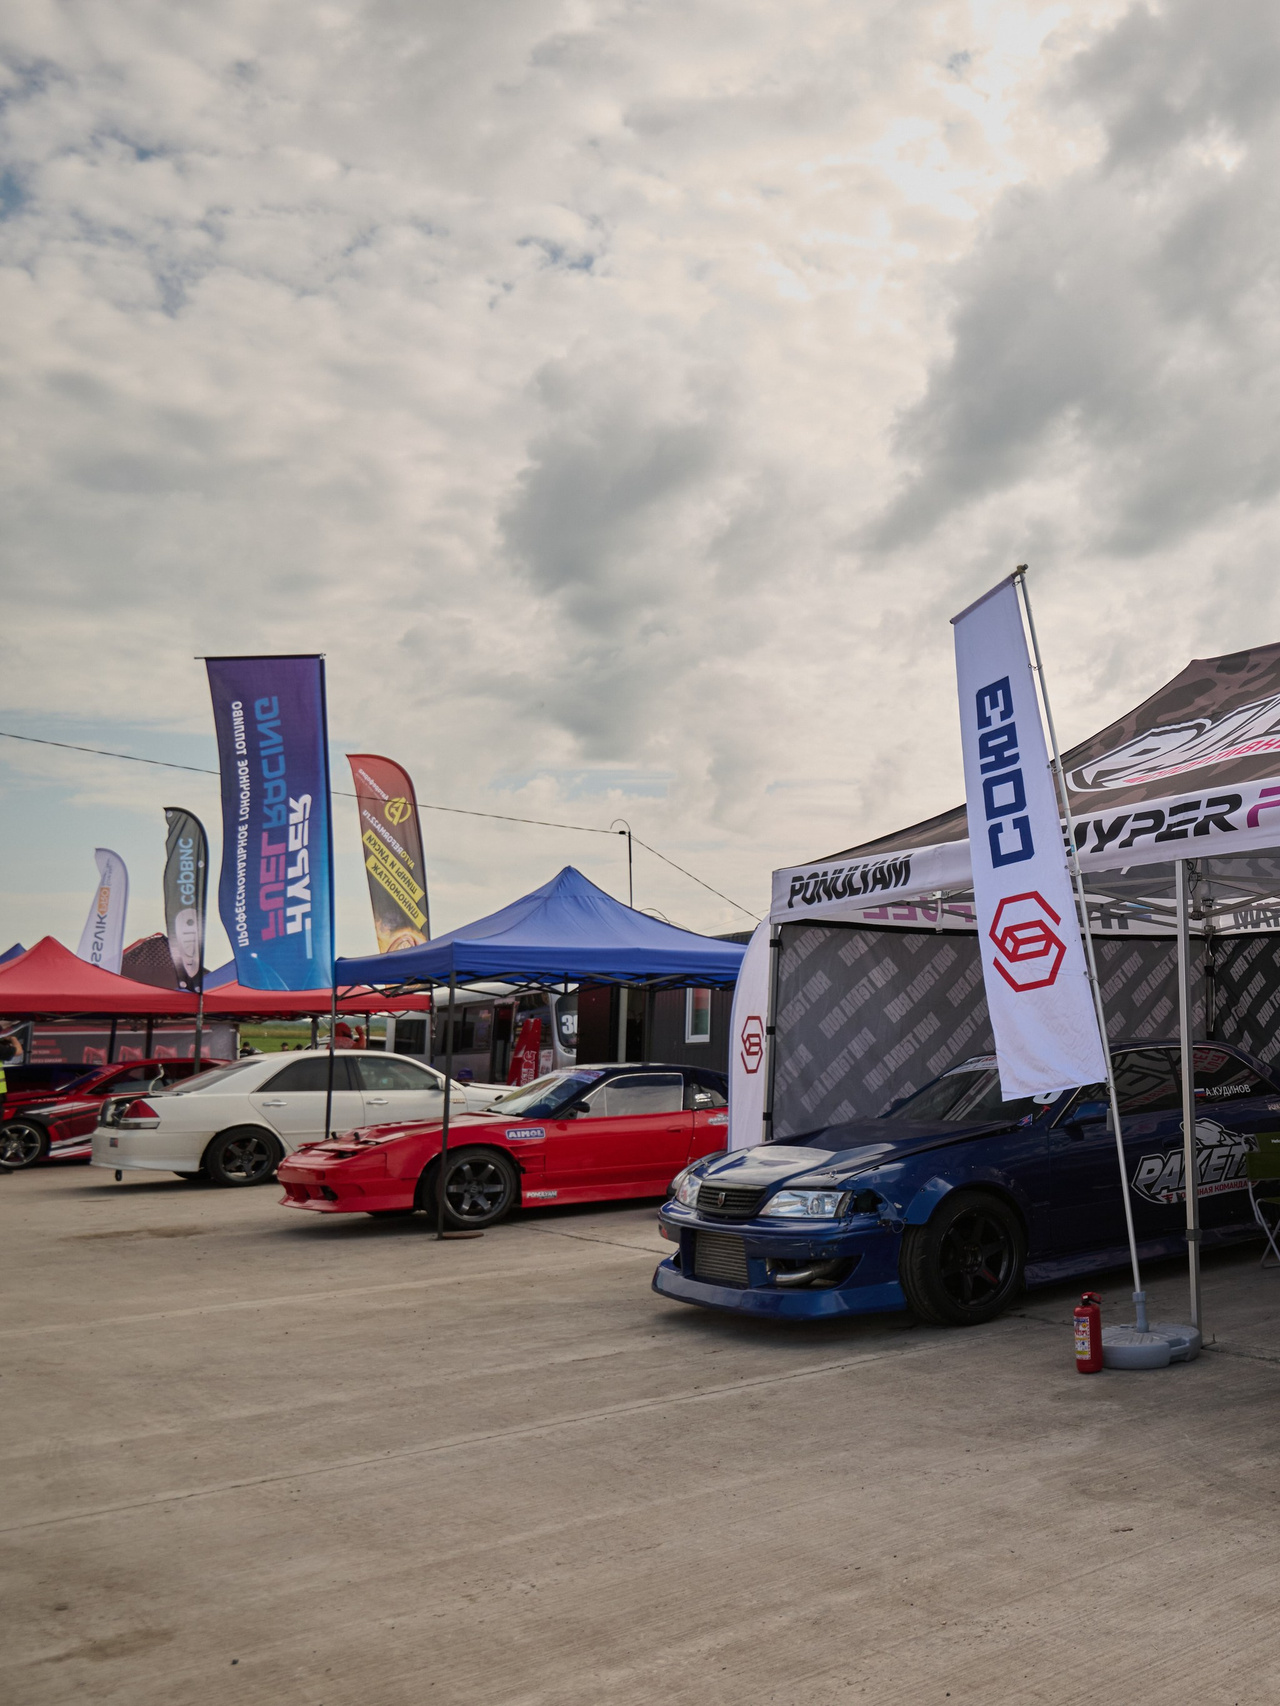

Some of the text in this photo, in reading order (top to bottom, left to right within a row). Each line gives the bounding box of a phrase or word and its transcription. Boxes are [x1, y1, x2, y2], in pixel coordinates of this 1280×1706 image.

[1062, 794, 1243, 858] HYPER
[787, 853, 913, 908] PONULYAM
[508, 1130, 544, 1138] AIMOL
